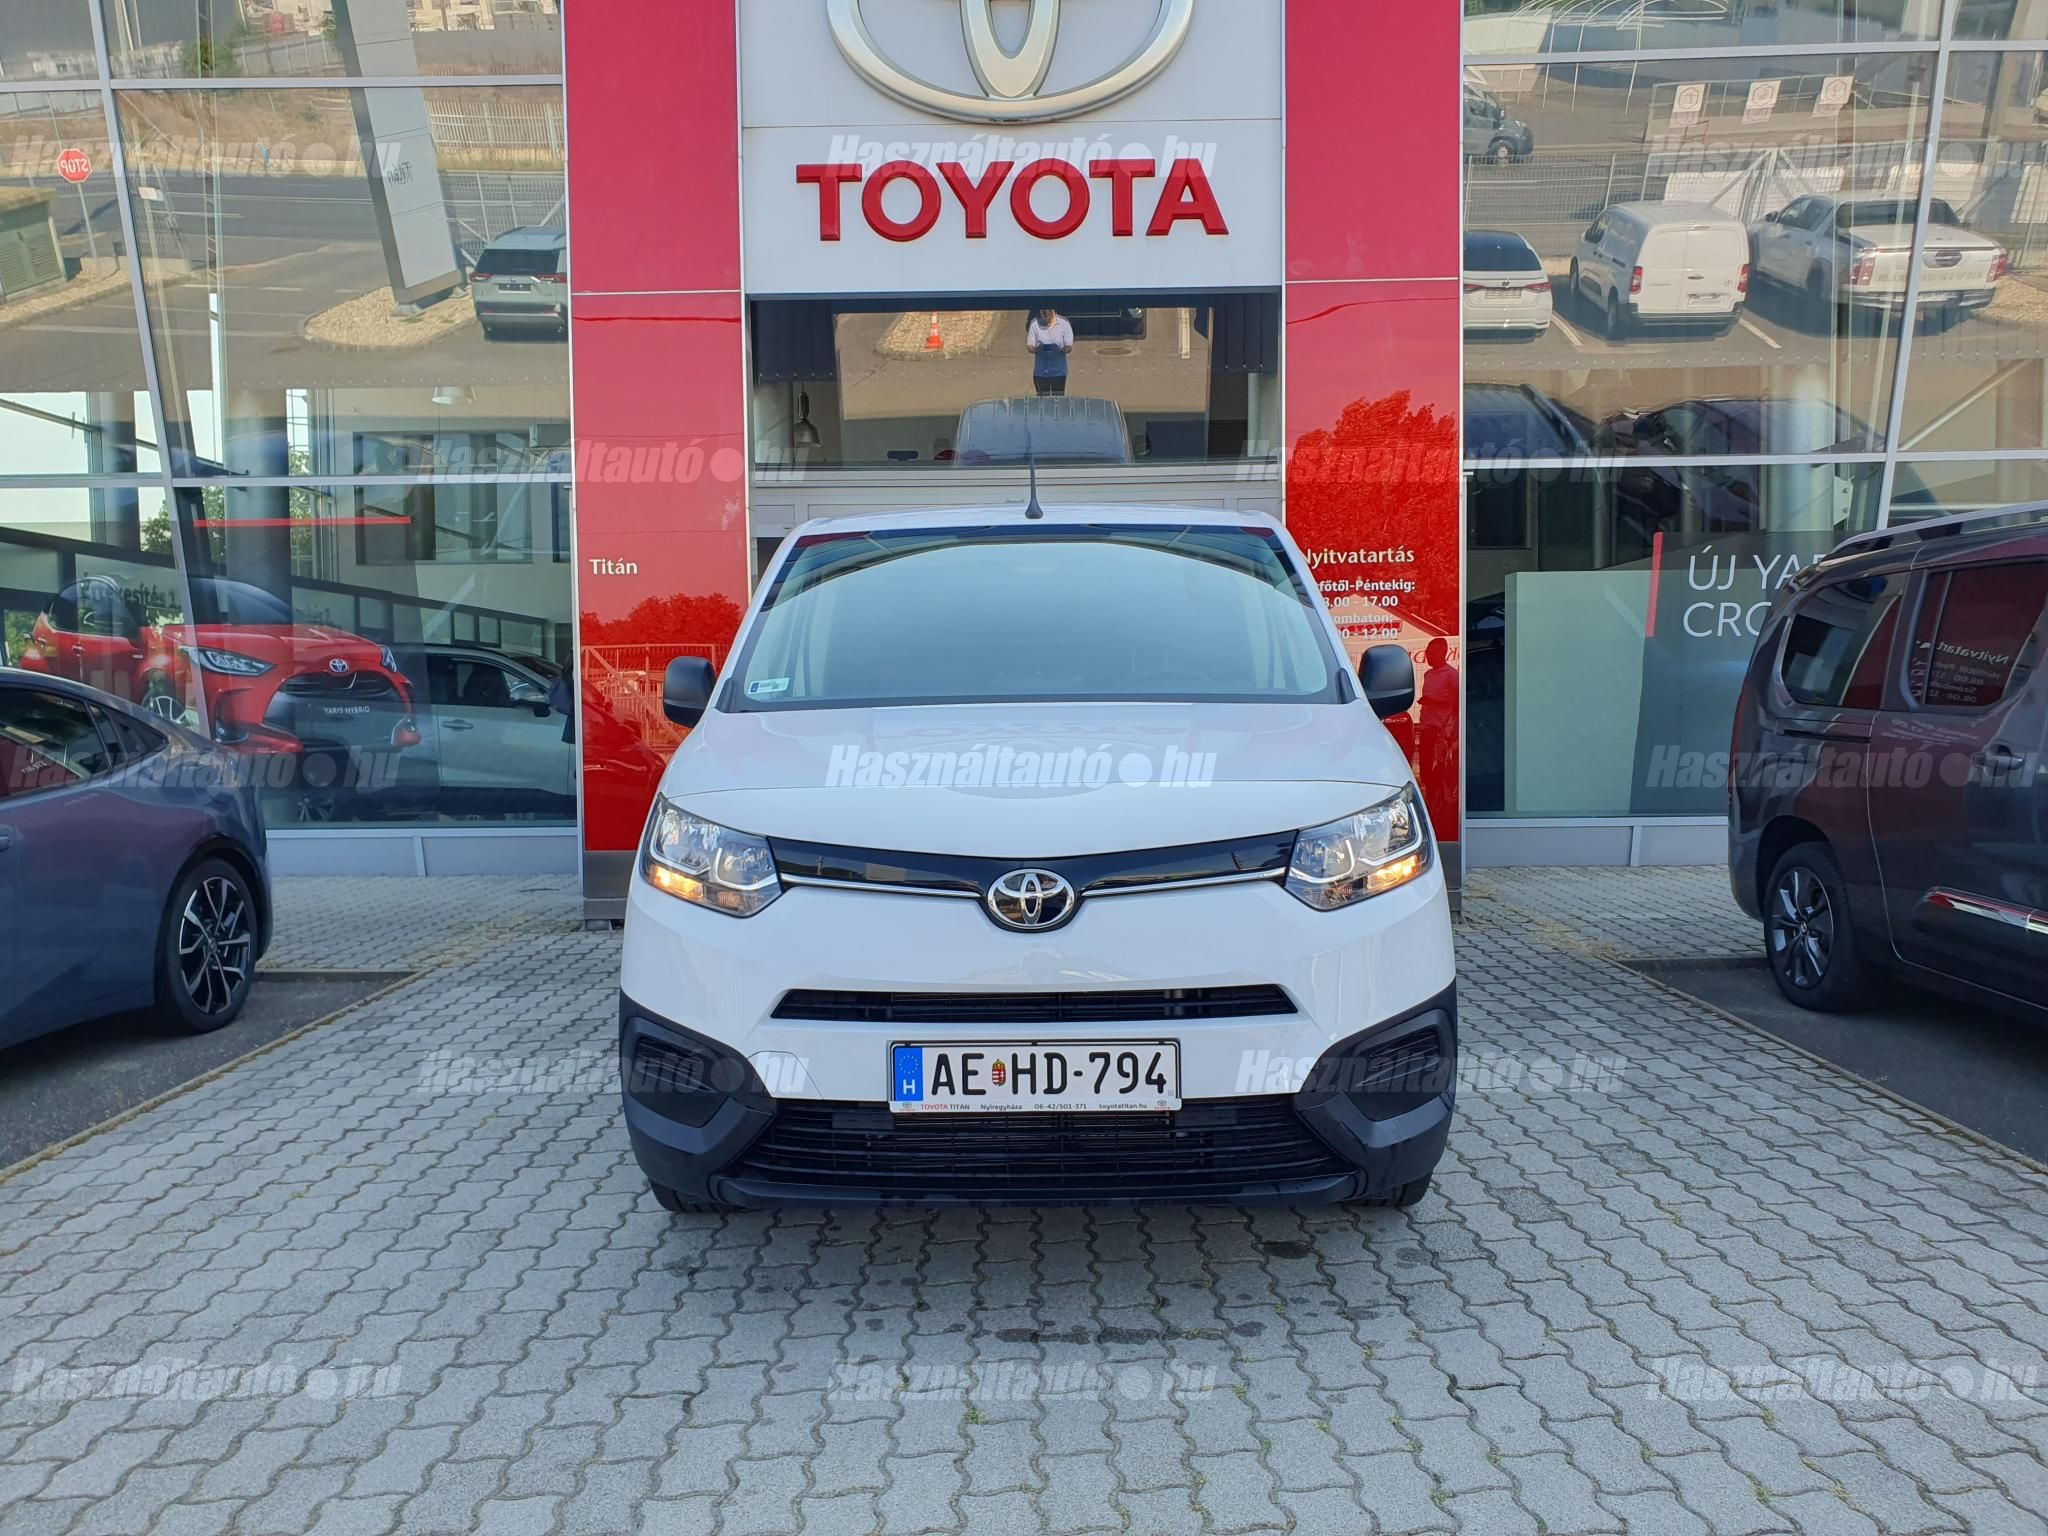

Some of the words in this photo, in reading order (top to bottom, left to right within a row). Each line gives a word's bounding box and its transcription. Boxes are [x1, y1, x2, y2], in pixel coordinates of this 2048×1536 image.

[796, 158, 1229, 241] TOYOTA
[588, 557, 638, 575] Titán
[1688, 545, 1736, 590] ÚJ
[1753, 554, 1826, 590] YA
[1317, 579, 1415, 593] főtől-Péntekig:
[1363, 595, 1398, 607] 17.00
[1332, 612, 1393, 624] ombaton:
[1362, 628, 1398, 639] 12.00
[324, 706, 344, 714] YARIS
[345, 705, 370, 714] HYBRID
[931, 1053, 987, 1096] AE
[1011, 1051, 1167, 1095] HD-794
[903, 1079, 915, 1095] H
[950, 1102, 970, 1110] TITÁN
[981, 1103, 1022, 1111] Nyíregyháza
[1099, 1103, 1148, 1111] toyotatitan.hu
